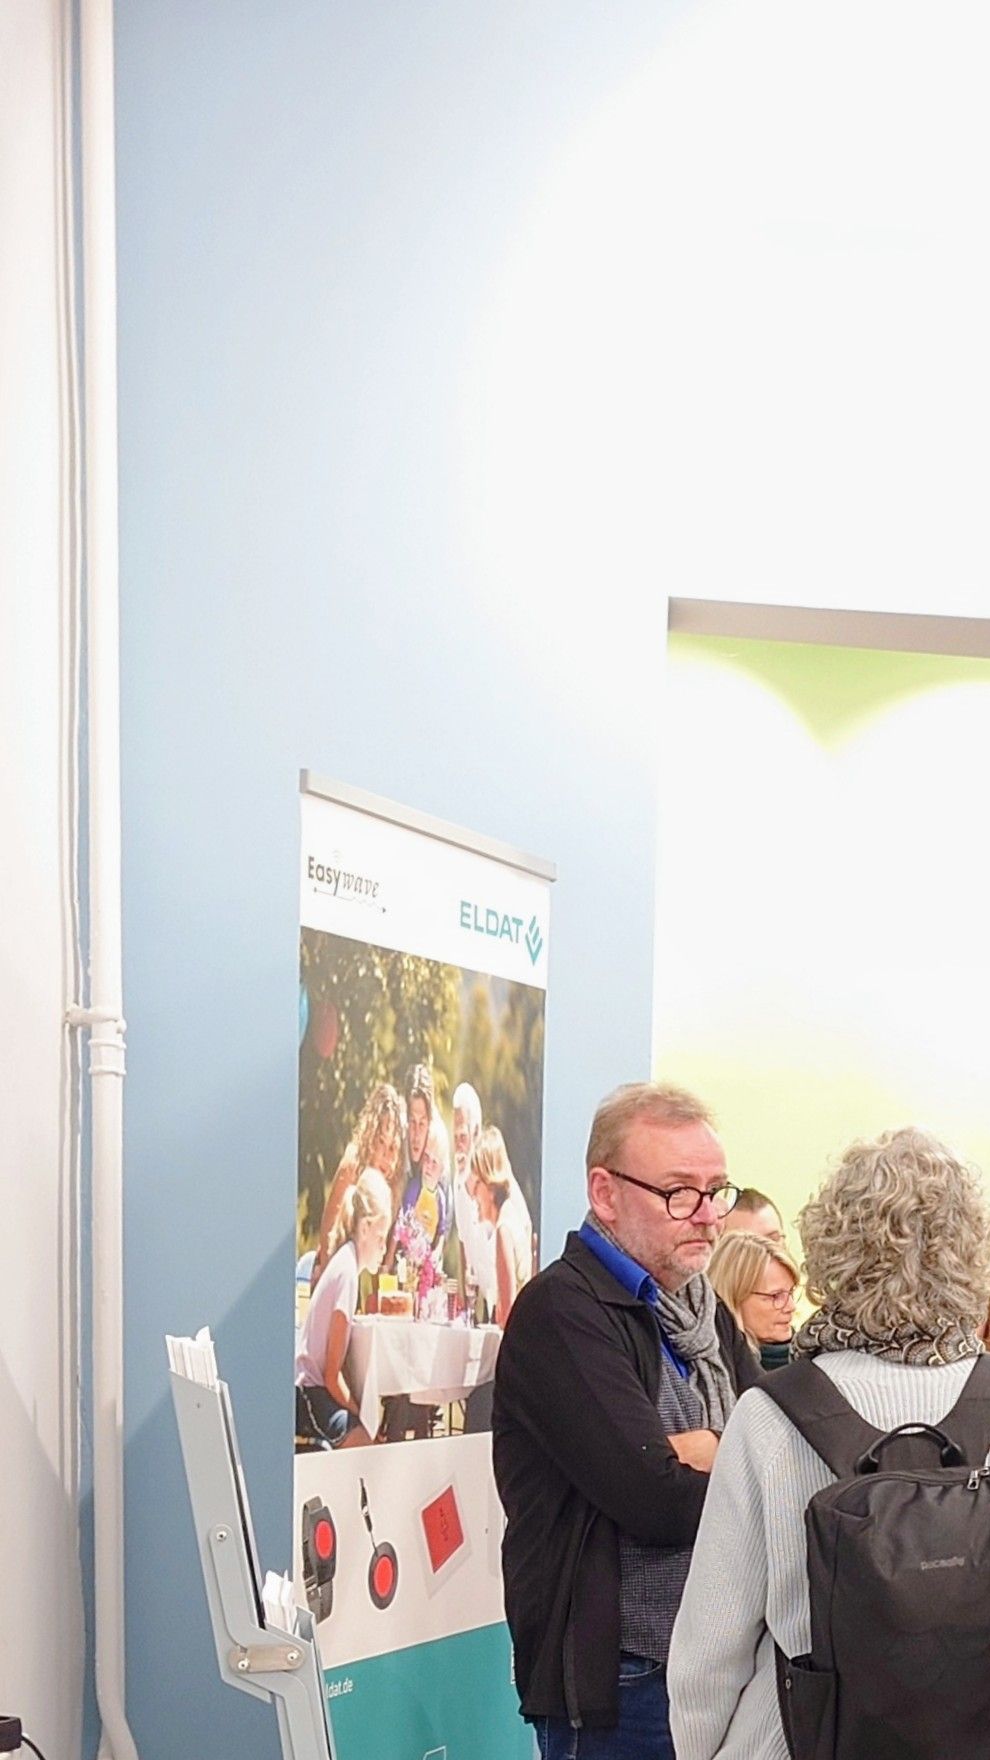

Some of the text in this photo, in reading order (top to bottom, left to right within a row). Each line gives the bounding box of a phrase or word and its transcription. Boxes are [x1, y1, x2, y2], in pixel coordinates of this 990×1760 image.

[308, 856, 379, 897] Easywave
[460, 900, 523, 943] ELDAT
[326, 1677, 353, 1698] ldat.de
